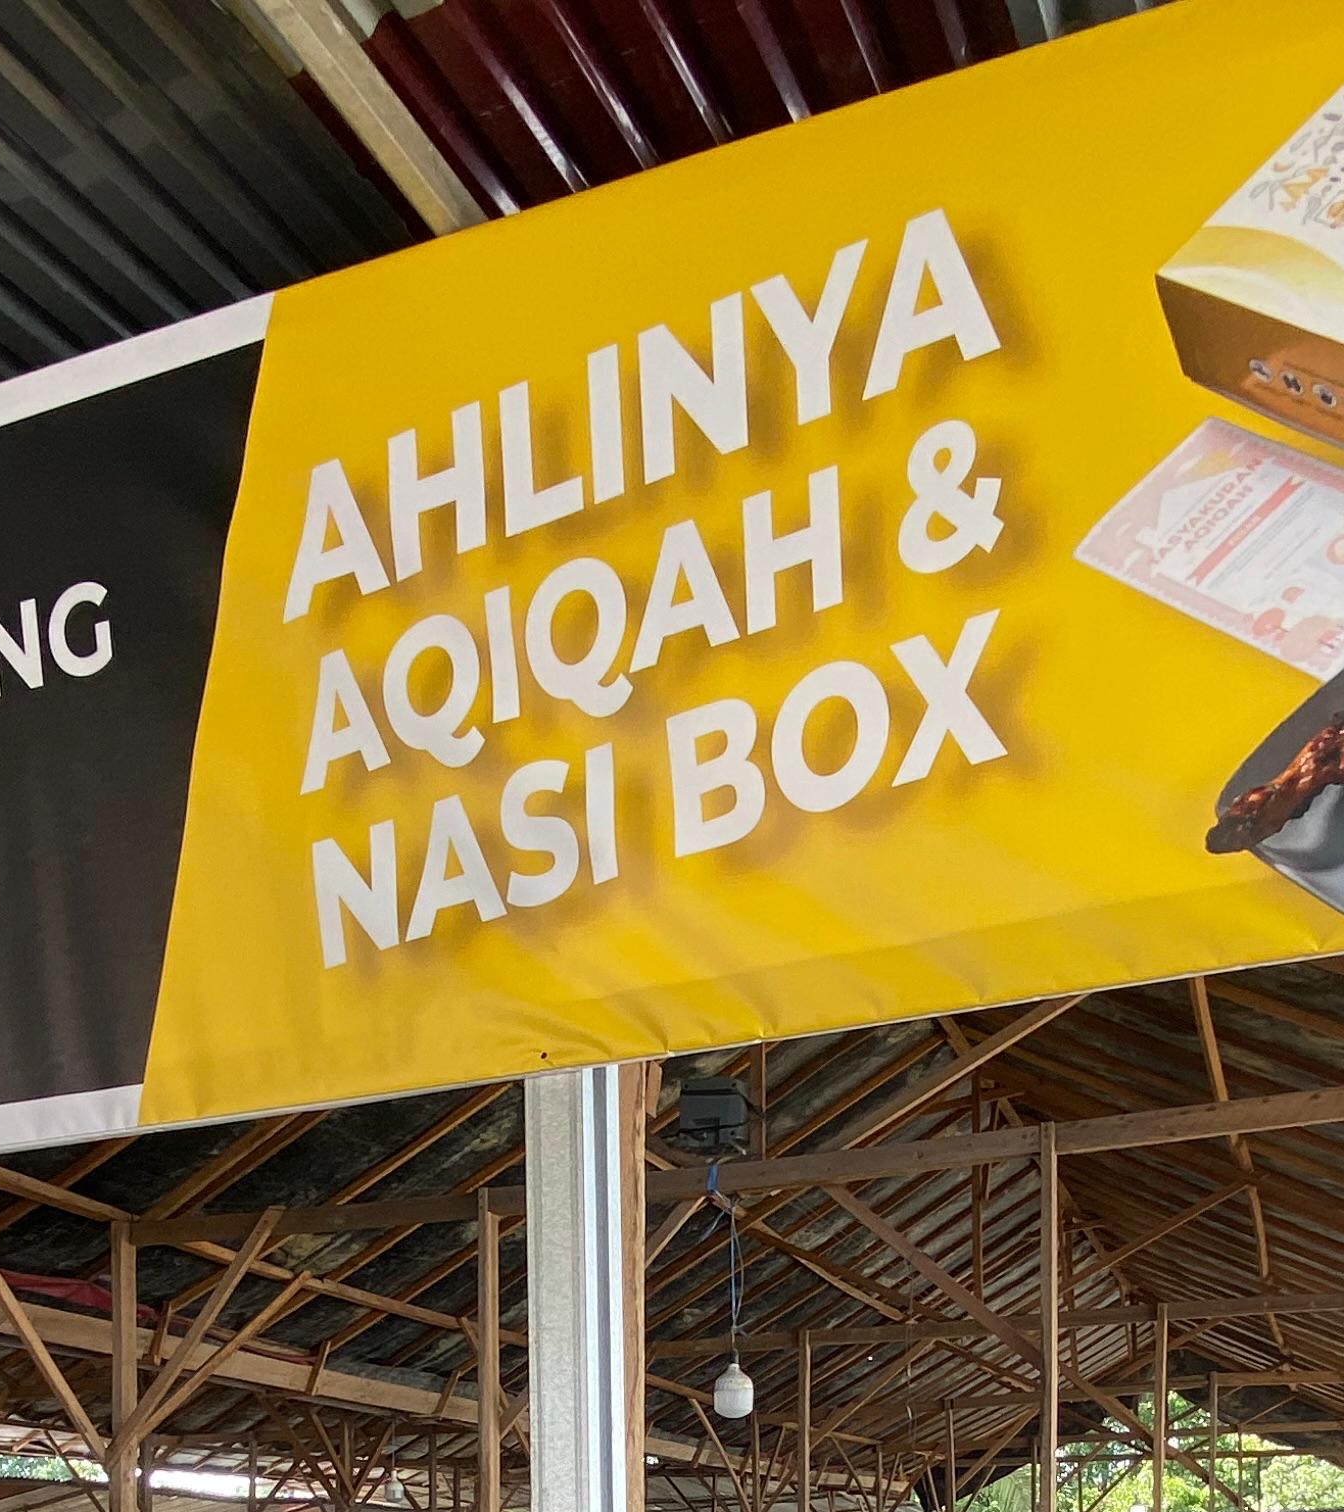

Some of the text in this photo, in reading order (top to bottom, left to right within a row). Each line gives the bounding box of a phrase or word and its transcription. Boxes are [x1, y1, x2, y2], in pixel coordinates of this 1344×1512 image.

[282, 208, 1002, 624] AHLINYA
[300, 465, 844, 795] AQIQAH
[898, 419, 1004, 574] &
[310, 609, 1009, 970] NASI BOX
